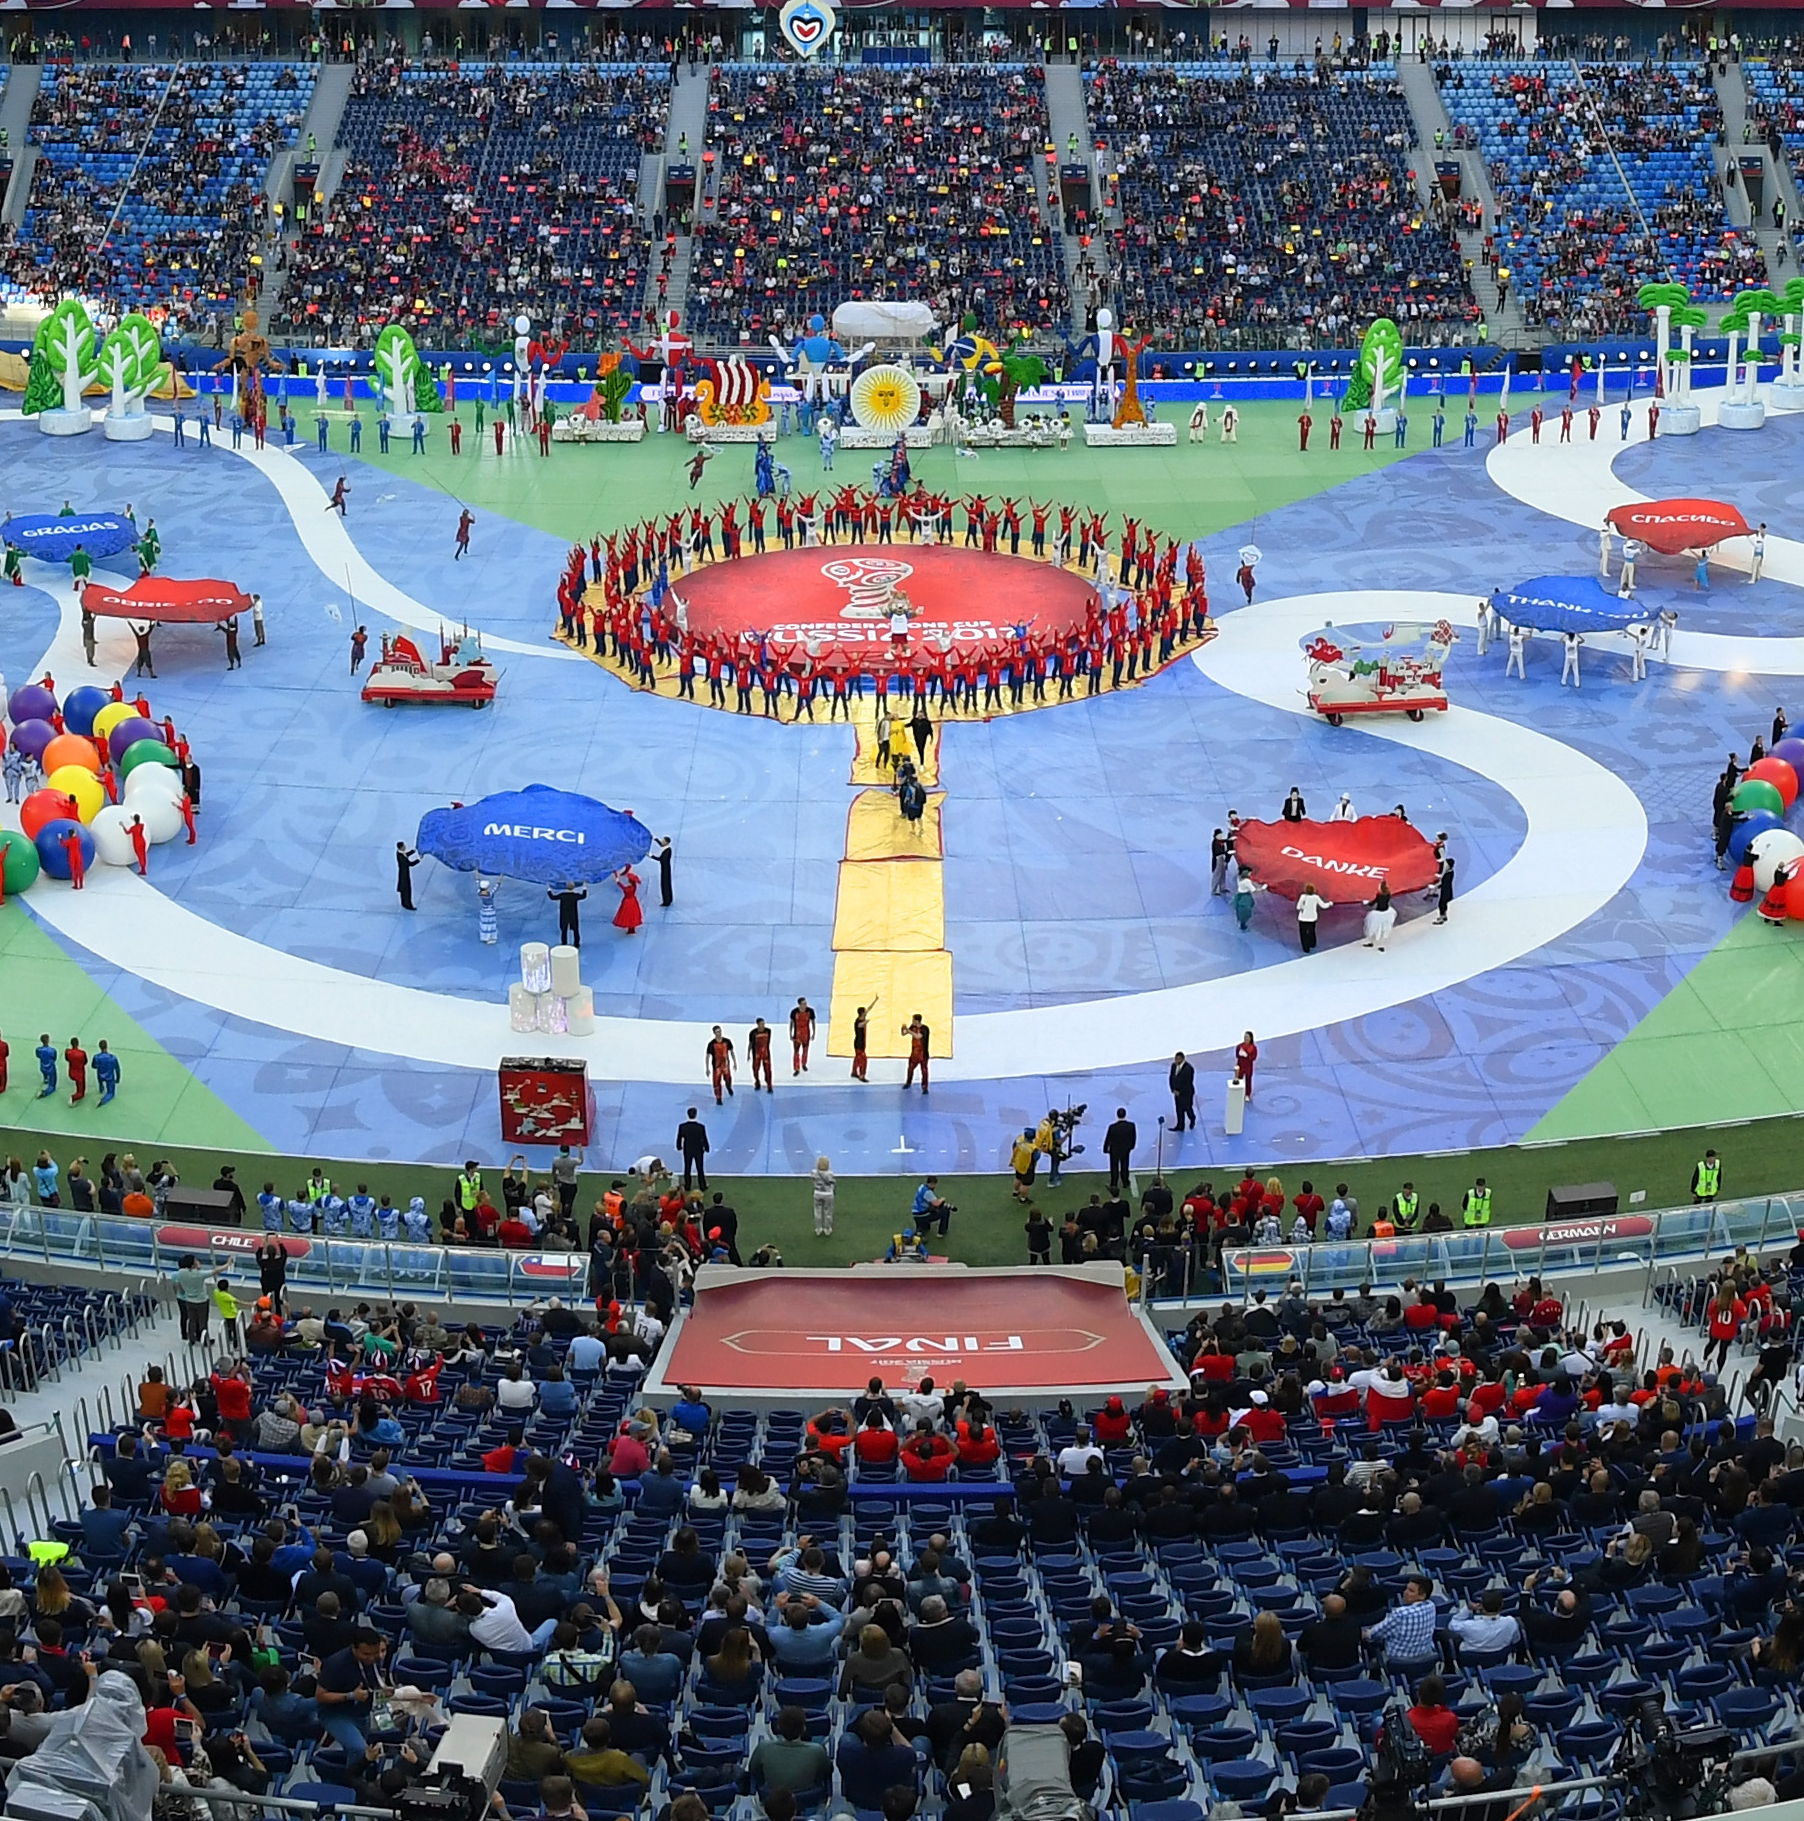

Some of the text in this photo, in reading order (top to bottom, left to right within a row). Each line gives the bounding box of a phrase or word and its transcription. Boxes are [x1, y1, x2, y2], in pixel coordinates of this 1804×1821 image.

[1630, 514, 1736, 527] СПАСИБО
[22, 521, 120, 537] GRACIAS
[1507, 594, 1593, 613] THANK
[953, 620, 992, 628] CUP
[483, 823, 585, 845] MERCI
[1280, 846, 1391, 880] DANKE
[211, 1235, 255, 1249] CHILE
[1717, 1309, 1733, 1325] 10
[805, 1336, 1025, 1352] FINAL
[418, 1380, 434, 1397] 17
